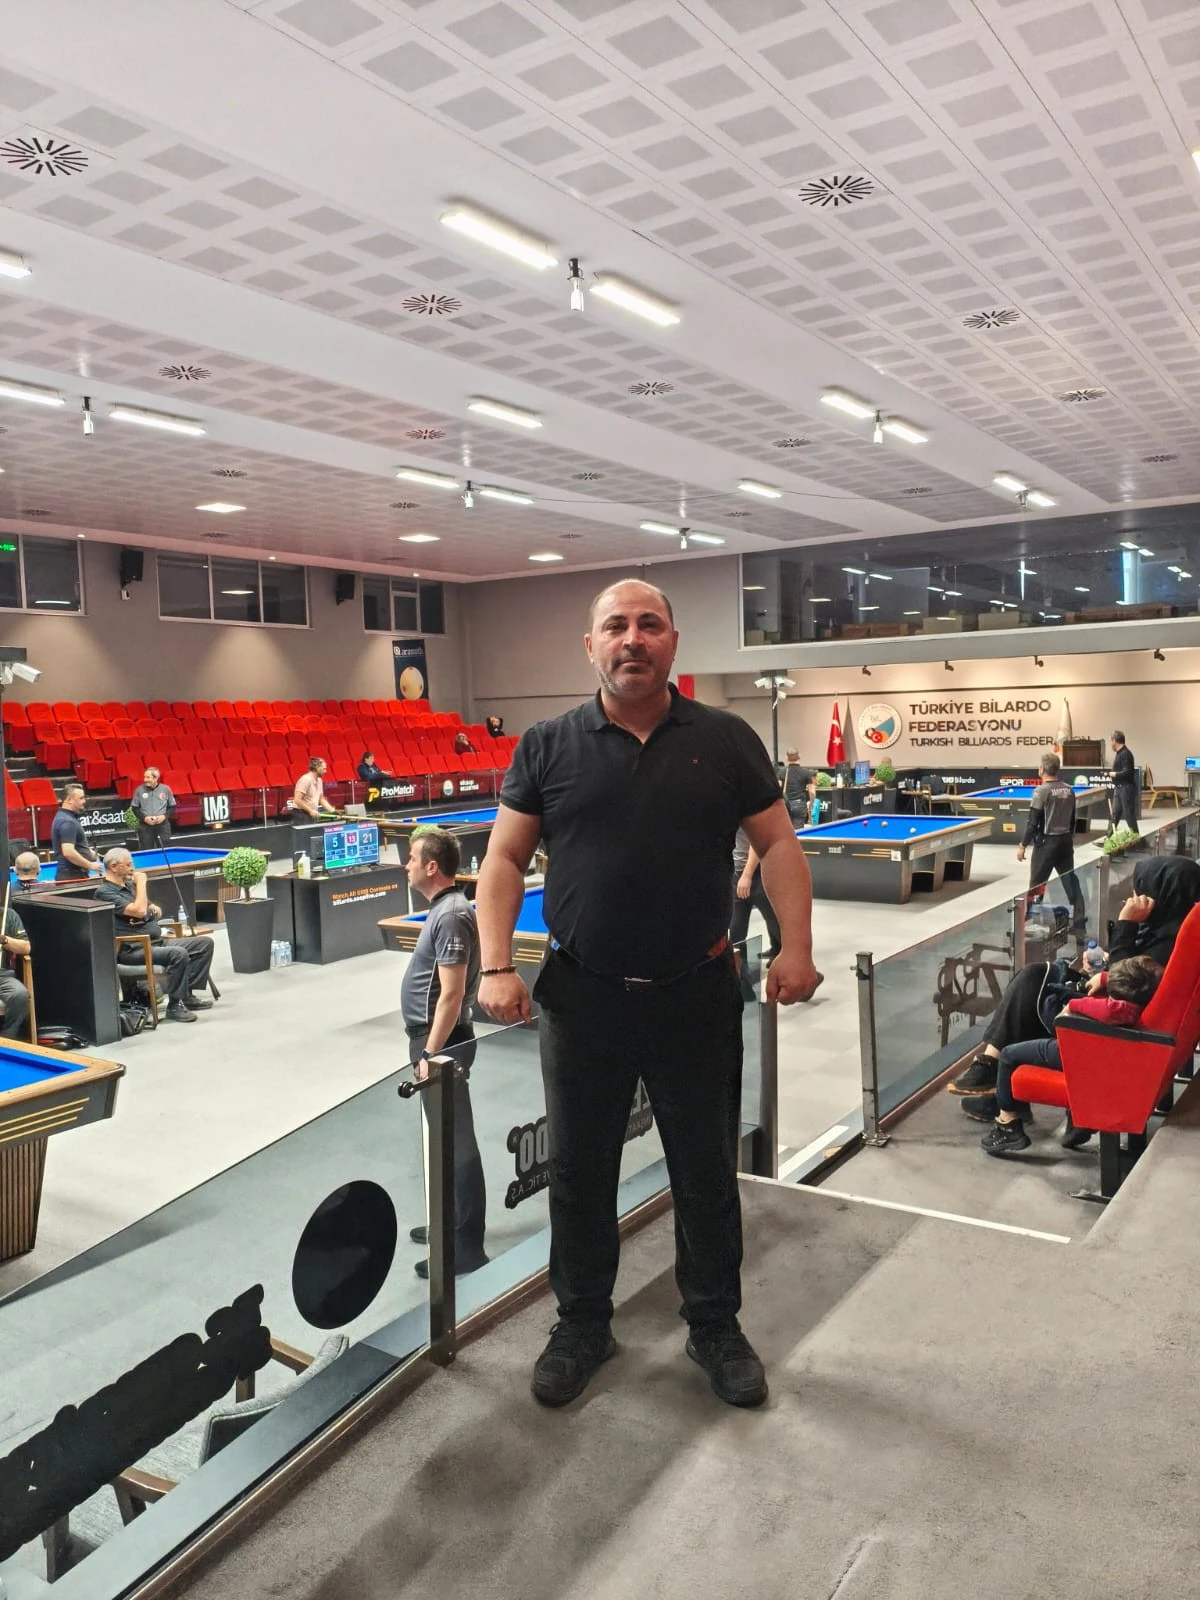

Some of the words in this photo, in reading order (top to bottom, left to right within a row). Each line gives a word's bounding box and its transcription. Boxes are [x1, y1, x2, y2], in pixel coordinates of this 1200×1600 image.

[909, 699, 974, 716] TÜRKİYE
[980, 698, 1051, 714] BİLARDO
[908, 718, 1022, 733] FEDERASYONU
[910, 737, 953, 747] TURKISH
[958, 735, 1012, 747] BILLIARDS
[381, 784, 415, 798] ProMatch
[332, 837, 339, 848] 5
[362, 832, 373, 844] 21
